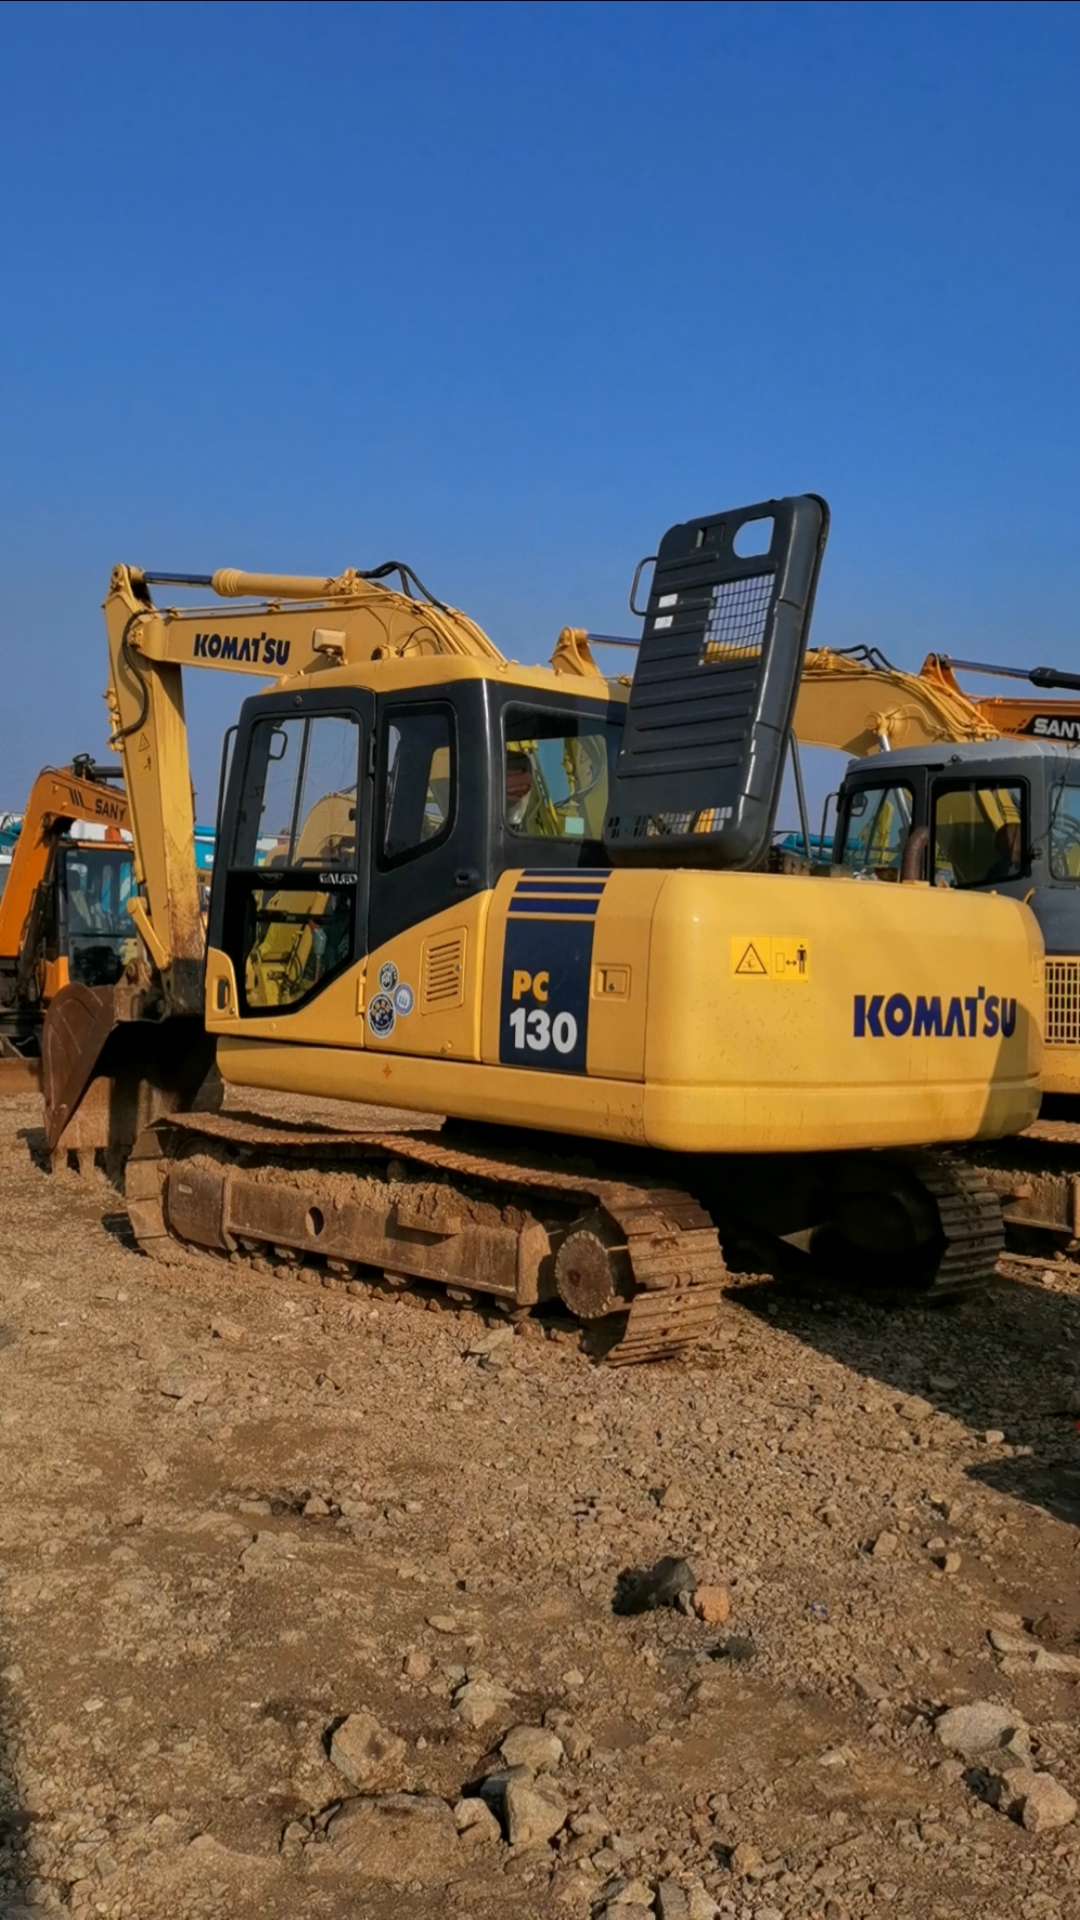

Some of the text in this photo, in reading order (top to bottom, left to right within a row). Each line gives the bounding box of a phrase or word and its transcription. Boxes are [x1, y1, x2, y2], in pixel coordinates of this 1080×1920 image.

[193, 632, 291, 666] KOMATSU
[95, 798, 127, 822] SANY
[511, 969, 549, 1001] PC
[853, 986, 1017, 1038] KOMATSU
[509, 1007, 578, 1054] 130
